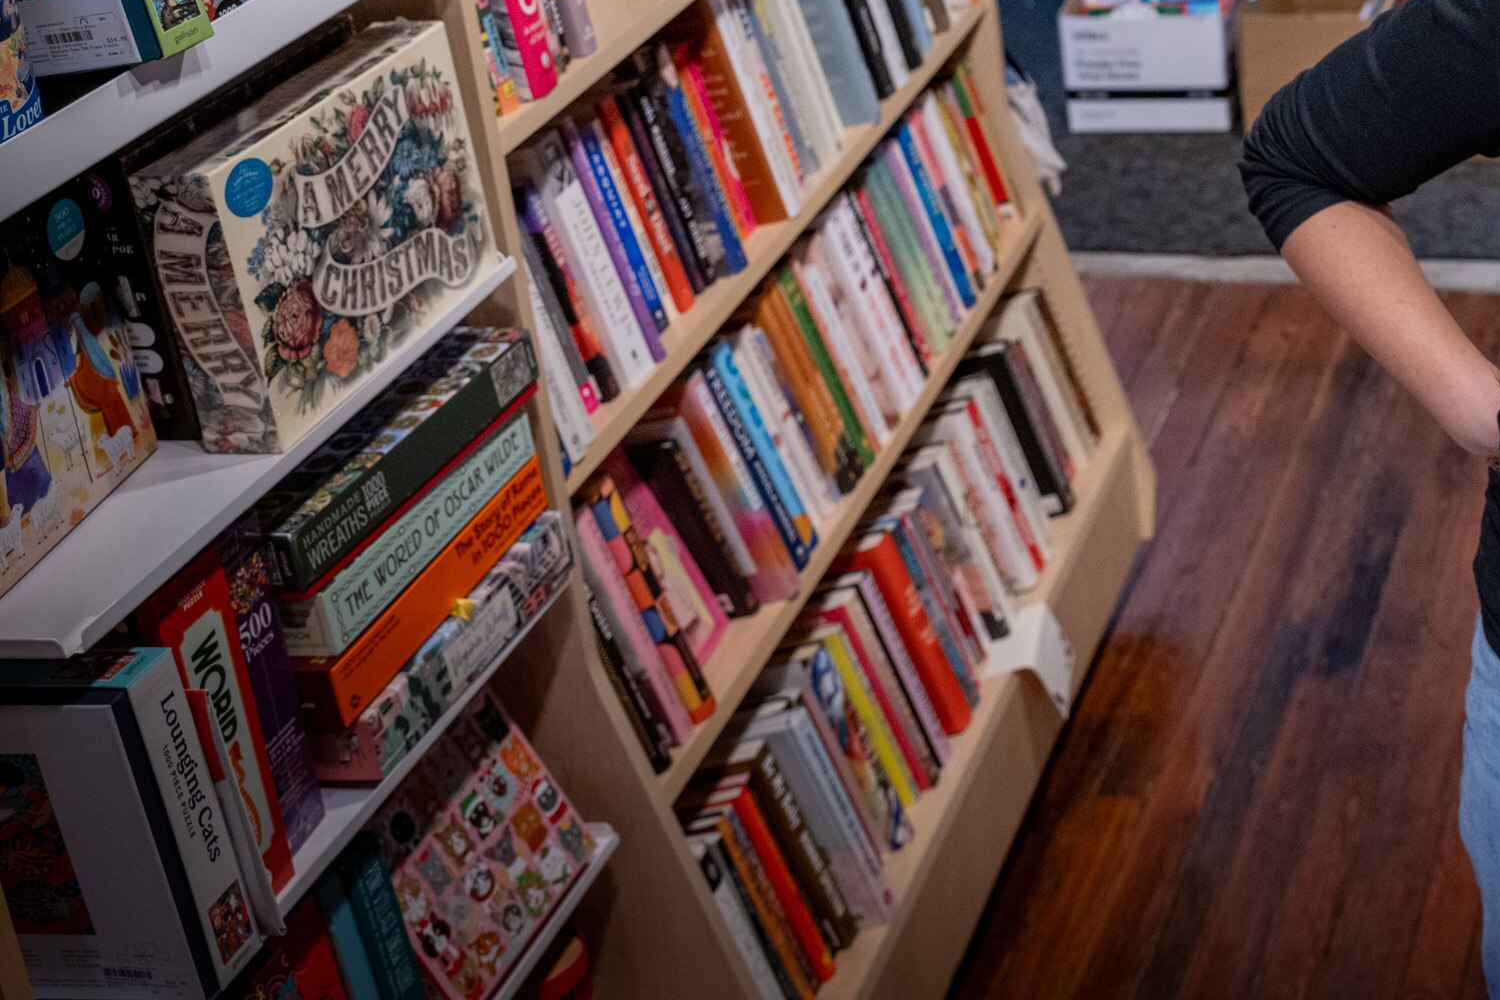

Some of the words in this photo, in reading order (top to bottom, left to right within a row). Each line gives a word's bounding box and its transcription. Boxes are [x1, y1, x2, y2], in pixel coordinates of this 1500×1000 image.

[173, 26, 199, 46] galison
[302, 180, 322, 225] A
[325, 86, 407, 211] MERRY
[156, 204, 204, 238] A
[319, 230, 472, 310] CHRISTMAS
[157, 253, 261, 406] MERRY
[360, 470, 388, 496] 1000
[364, 486, 391, 512] PIECE
[302, 489, 362, 551] HANDMADE
[306, 506, 370, 572] WREATHS
[346, 583, 374, 618] THE
[373, 529, 424, 588] WORLD
[423, 504, 441, 539] OF
[442, 464, 485, 521] OSCAR
[482, 429, 522, 481] WILDE
[239, 600, 273, 651] 500
[245, 630, 276, 663] Pieces
[160, 689, 206, 812] Lounging
[198, 805, 222, 864] Cats
[162, 744, 174, 769] 1000
[171, 770, 184, 801] PIECE
[180, 801, 196, 840] PUZZLE
